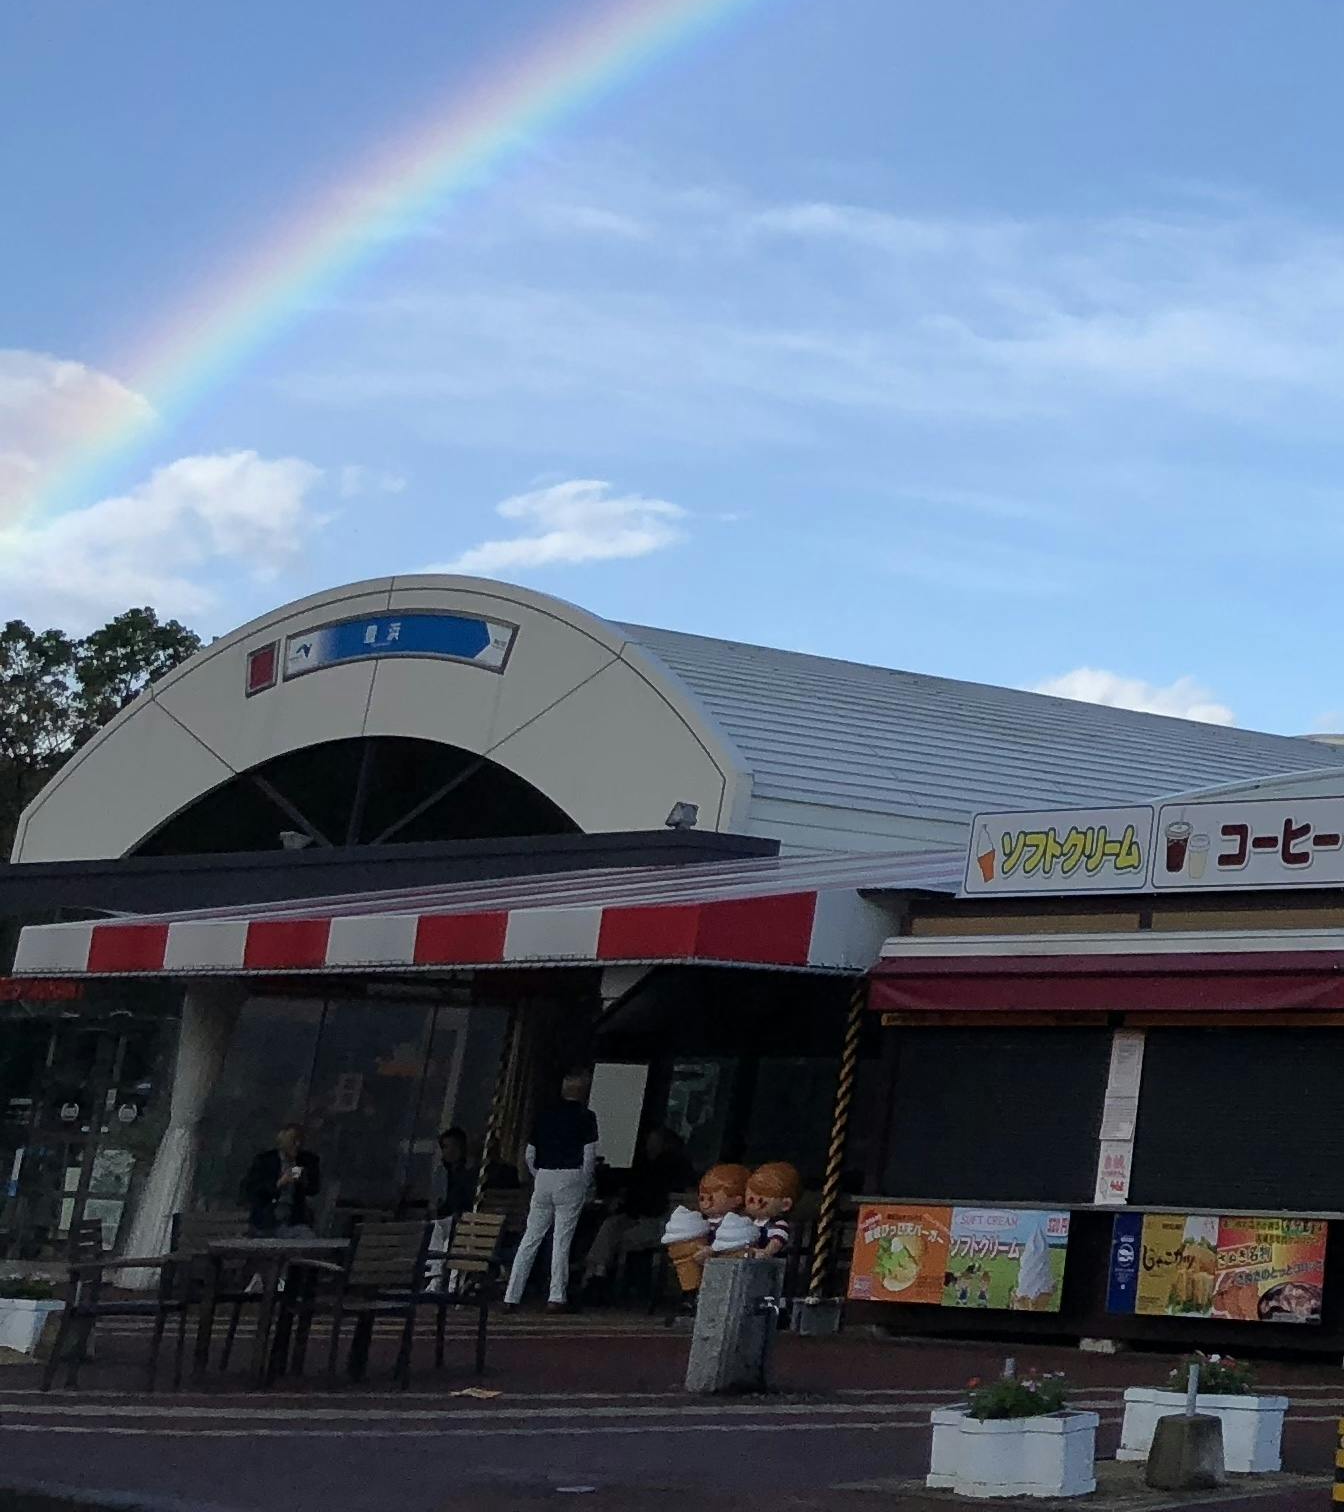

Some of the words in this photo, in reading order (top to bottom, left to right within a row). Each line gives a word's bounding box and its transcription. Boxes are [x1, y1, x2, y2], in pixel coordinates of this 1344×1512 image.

[1000, 824, 1143, 876] ソフトクリーム
[1217, 818, 1343, 871] コーヒー
[950, 1235, 1019, 1259] ソフトクリーム
